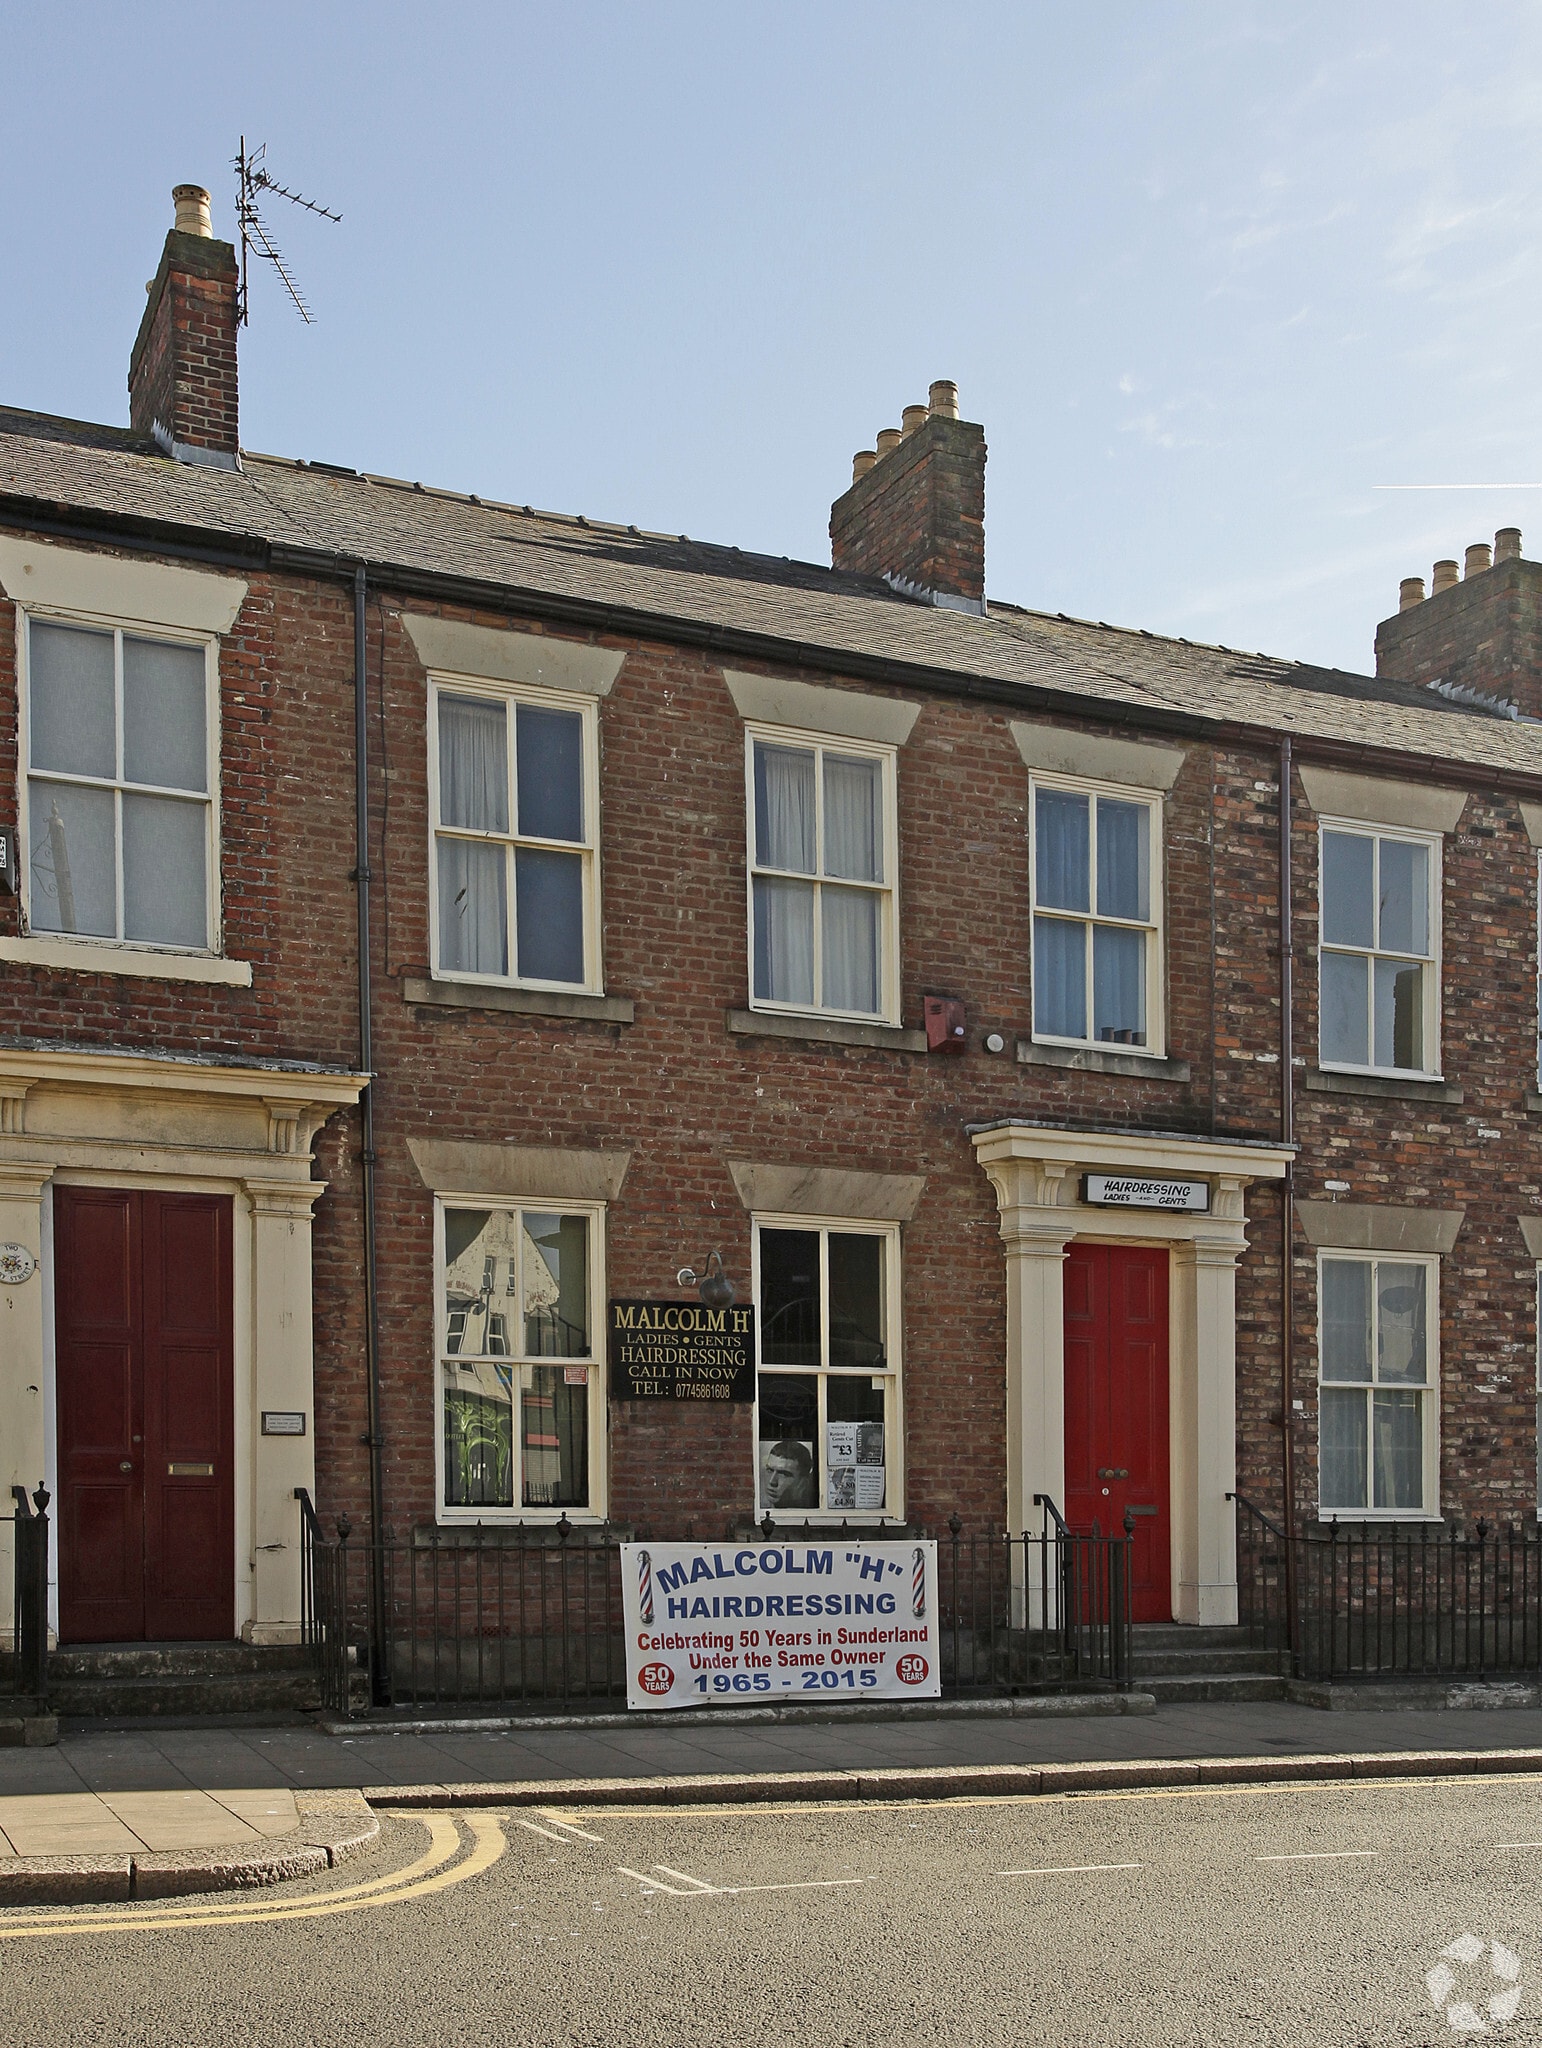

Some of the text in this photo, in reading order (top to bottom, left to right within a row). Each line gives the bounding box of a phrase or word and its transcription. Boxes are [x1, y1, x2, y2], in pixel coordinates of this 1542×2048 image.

[1104, 1180, 1191, 1197] HAIRDRESSING
[1103, 1193, 1131, 1201] LADIES
[1158, 1196, 1187, 1205] GENTS
[614, 1305, 726, 1332] MALCOLM
[626, 1333, 741, 1347] LADIES GENTS
[620, 1346, 747, 1366] HAIRDRESSING
[628, 1365, 739, 1380] CALL IN NOW
[675, 1383, 730, 1399] 07745861608
[655, 1549, 833, 1595] MALCOLM
[667, 1592, 896, 1619] HAIRDRESSING
[637, 1625, 929, 1653] Celebrating 50 Years in Sunderland
[689, 1648, 886, 1670] Under the Same Owner
[900, 1658, 924, 1672] 50
[644, 1669, 670, 1683] 50
[693, 1672, 772, 1693] 1965
[801, 1669, 878, 1690] 2015
[901, 1671, 925, 1682] YEARS
[644, 1681, 670, 1691] YEARS
